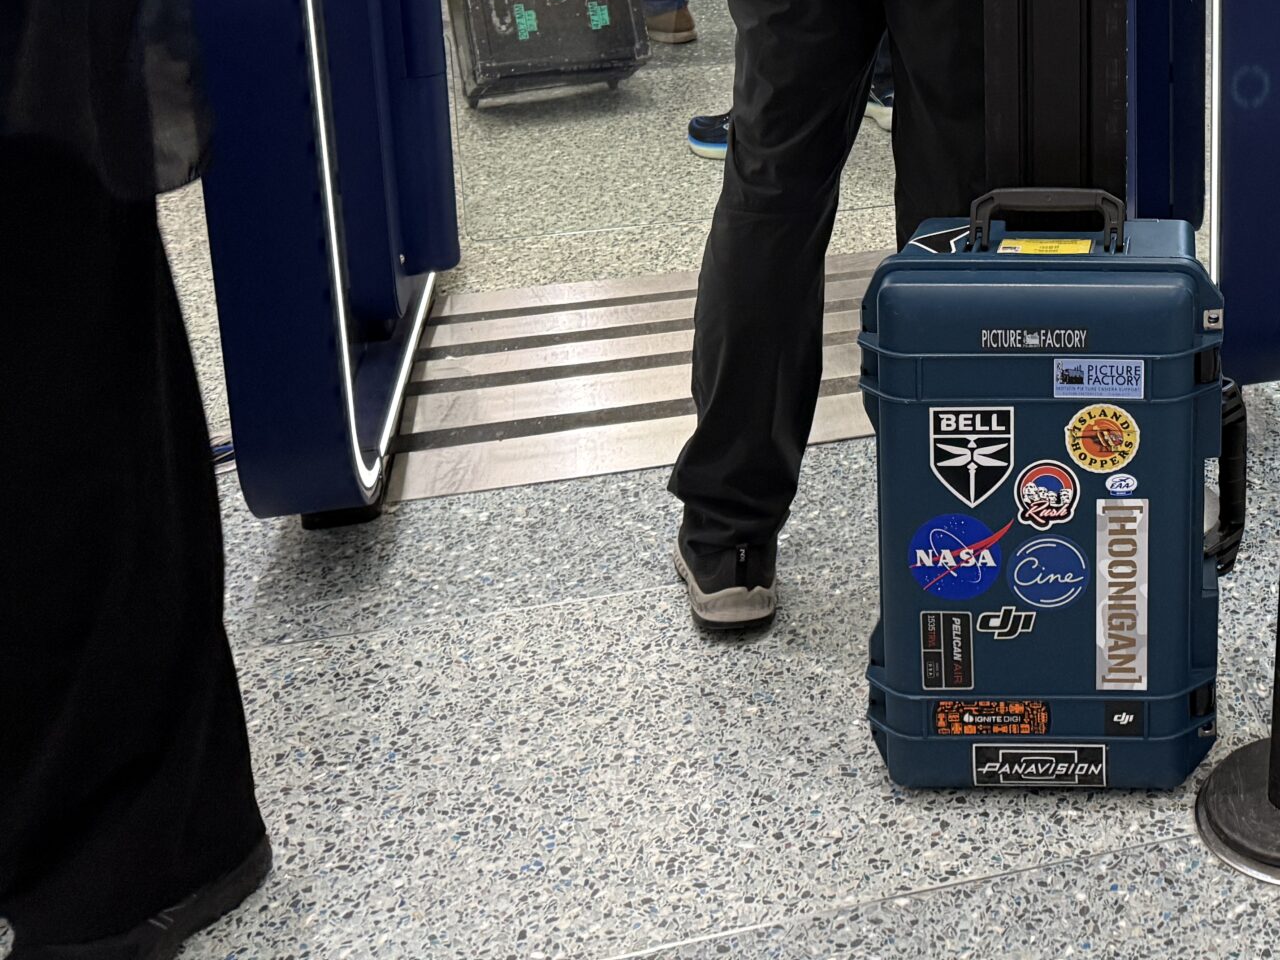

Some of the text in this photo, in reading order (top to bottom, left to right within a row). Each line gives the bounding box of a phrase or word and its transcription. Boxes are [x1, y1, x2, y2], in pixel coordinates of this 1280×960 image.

[981, 330, 1087, 348] PICTURE FACTORY
[1087, 364, 1141, 376] PICTURE
[1087, 375, 1141, 386] FACTORY
[940, 413, 1007, 431] BELL
[1071, 409, 1130, 435] ISLAND
[1071, 441, 1133, 468] HOPPERS
[1025, 500, 1070, 524] Rush
[915, 549, 997, 567] NASA
[1013, 557, 1084, 587] Cine
[951, 616, 962, 663] PELICAN
[974, 715, 1021, 723] IGNITE DIGI
[977, 762, 1103, 775] PANAVISION
